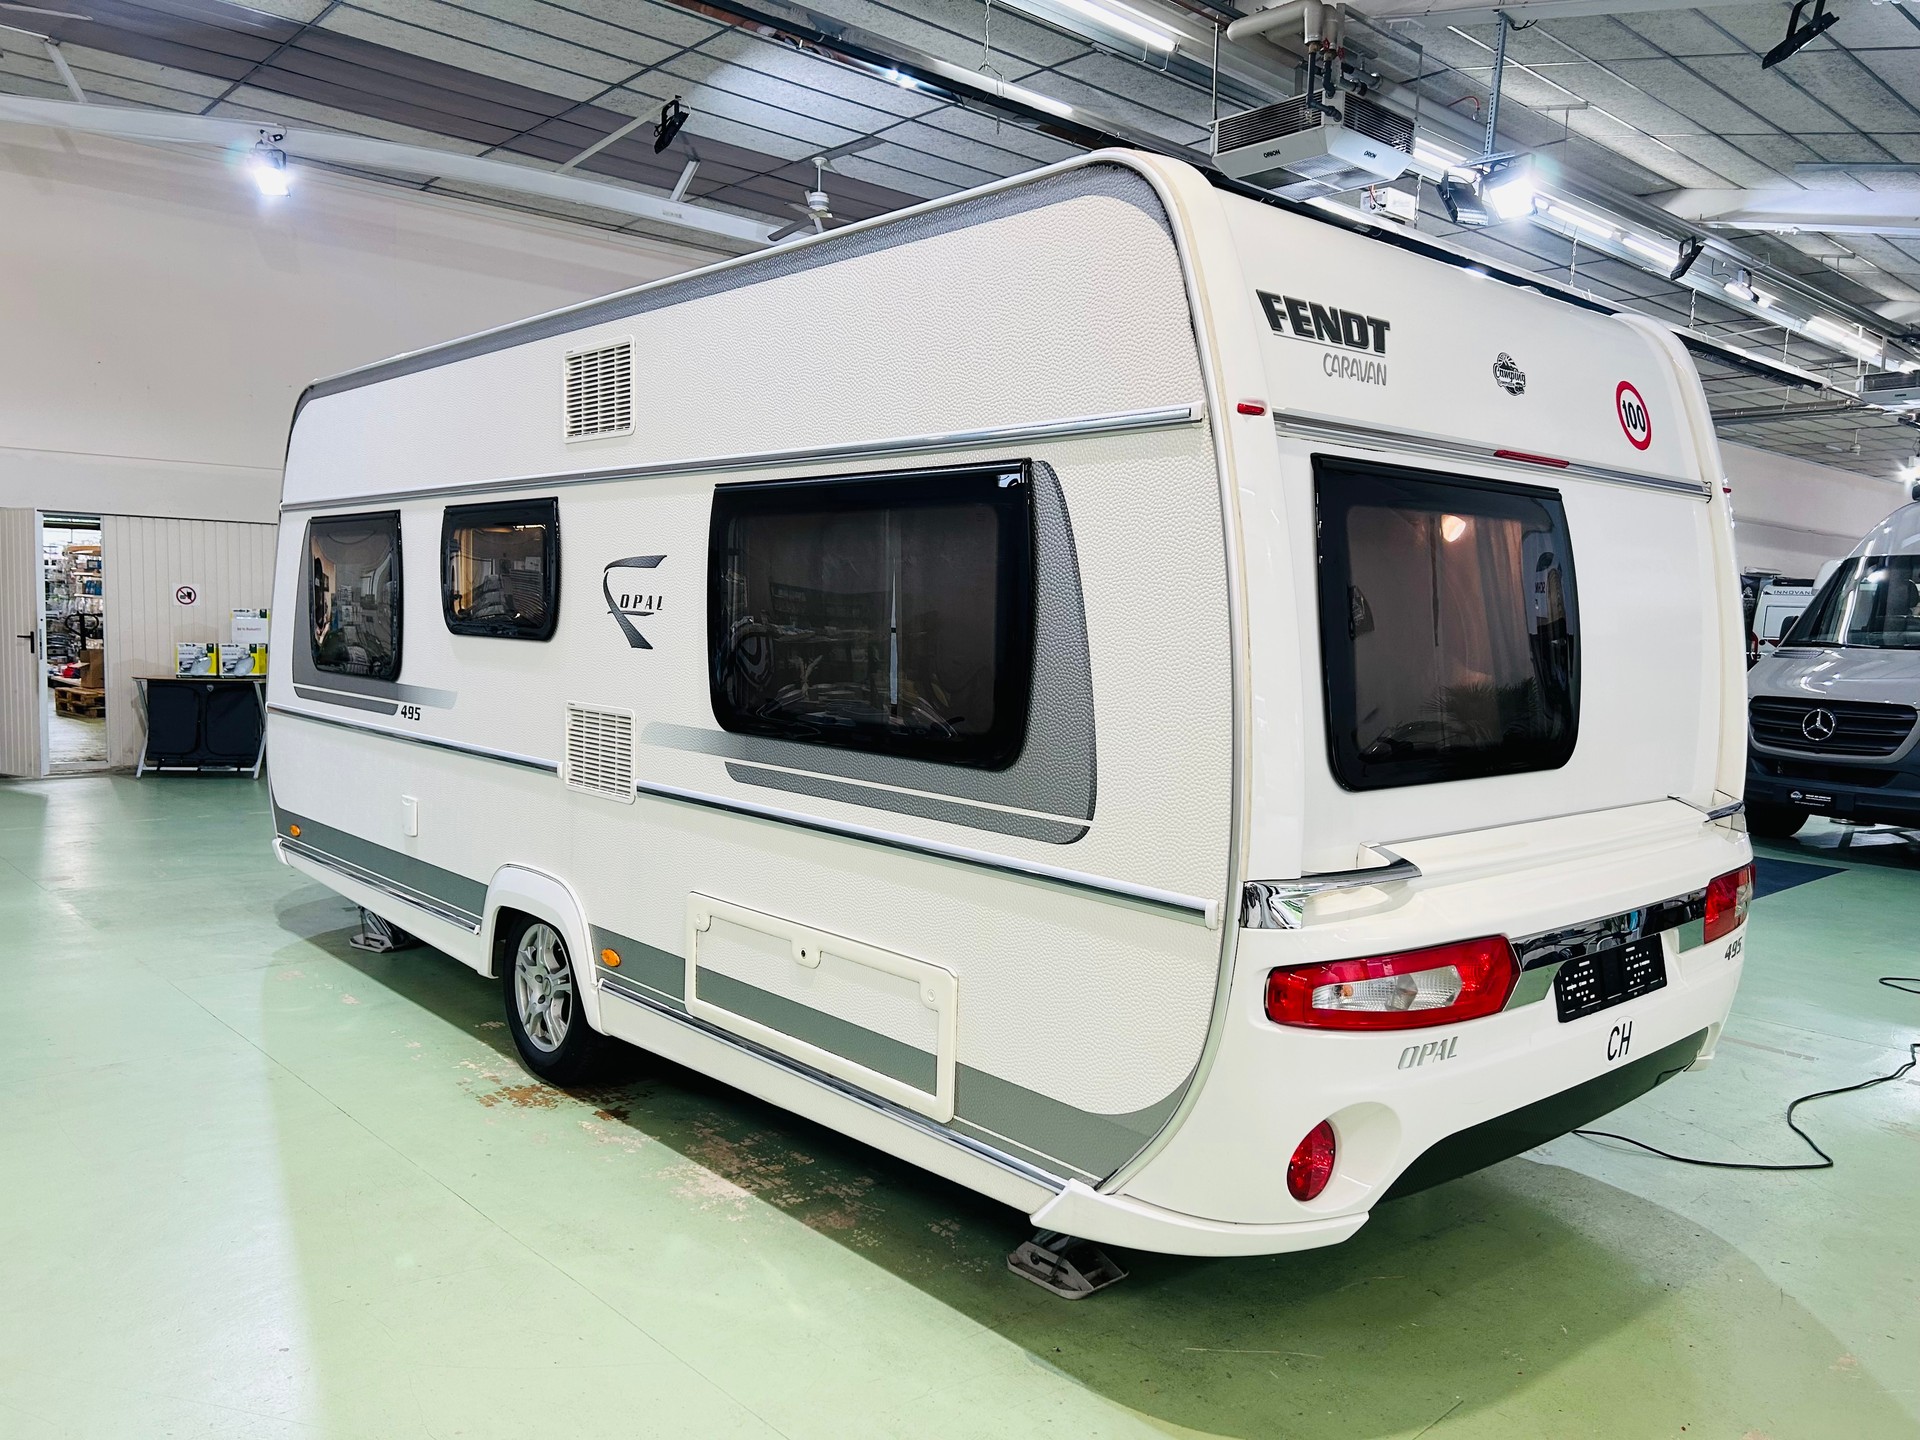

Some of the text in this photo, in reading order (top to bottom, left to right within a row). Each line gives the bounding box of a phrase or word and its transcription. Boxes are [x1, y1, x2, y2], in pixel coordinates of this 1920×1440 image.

[1263, 149, 1281, 159] ORION
[1255, 288, 1391, 354] FENDT
[1323, 352, 1387, 386] CARAVAN
[1493, 364, 1526, 386] Camping
[1622, 400, 1646, 433] 100
[620, 594, 663, 611] OPAL
[401, 705, 421, 721] 495
[1724, 936, 1743, 960] 495
[1397, 1036, 1459, 1070] OPAL
[1607, 1020, 1633, 1061] CH
